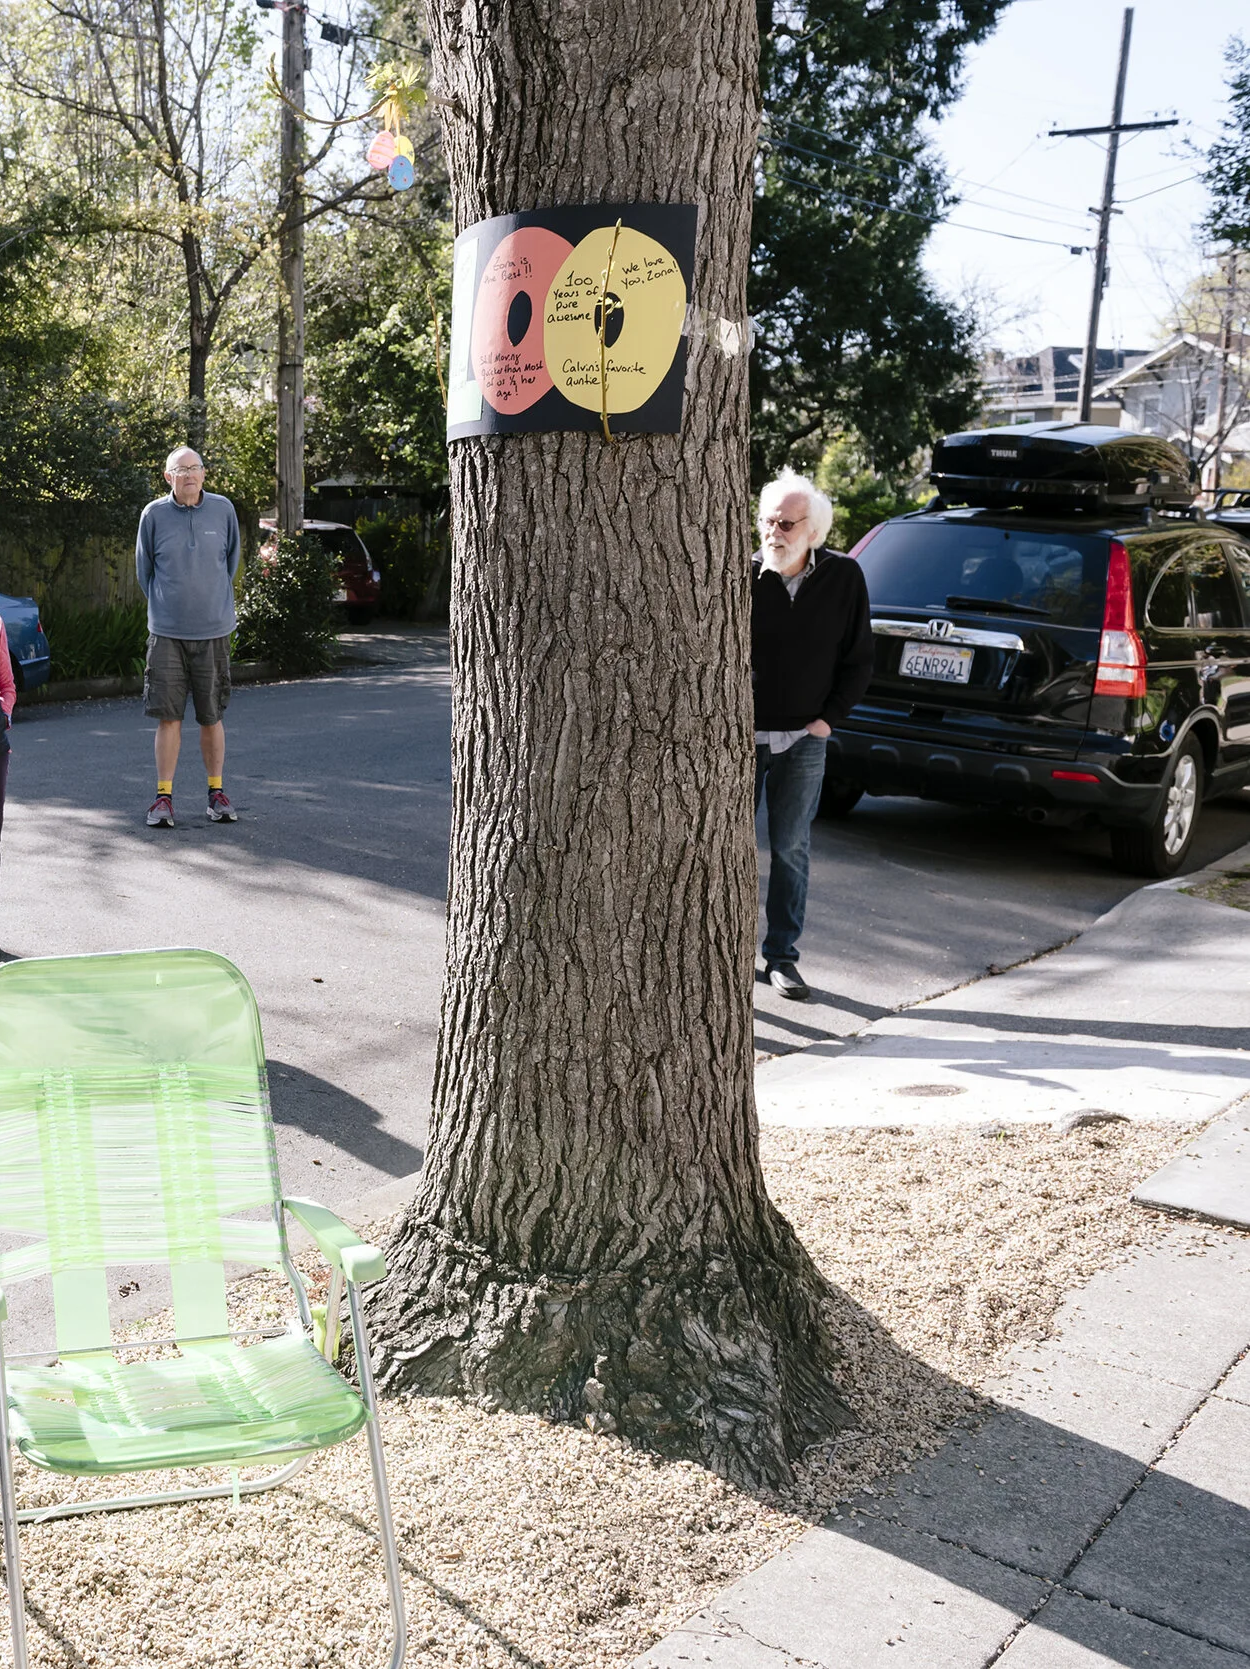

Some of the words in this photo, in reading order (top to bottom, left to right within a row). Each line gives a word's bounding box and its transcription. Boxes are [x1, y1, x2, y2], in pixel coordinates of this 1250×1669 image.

[493, 255, 517, 271] Zona
[520, 257, 529, 265] is
[621, 262, 640, 275] We
[643, 257, 665, 268] love
[646, 260, 679, 281] Zona!
[564, 270, 593, 287] 100
[585, 285, 599, 296] of
[605, 358, 647, 375] favorite
[520, 375, 537, 384] her
[990, 448, 1018, 458] THULE
[905, 655, 964, 677] 6ENR941
